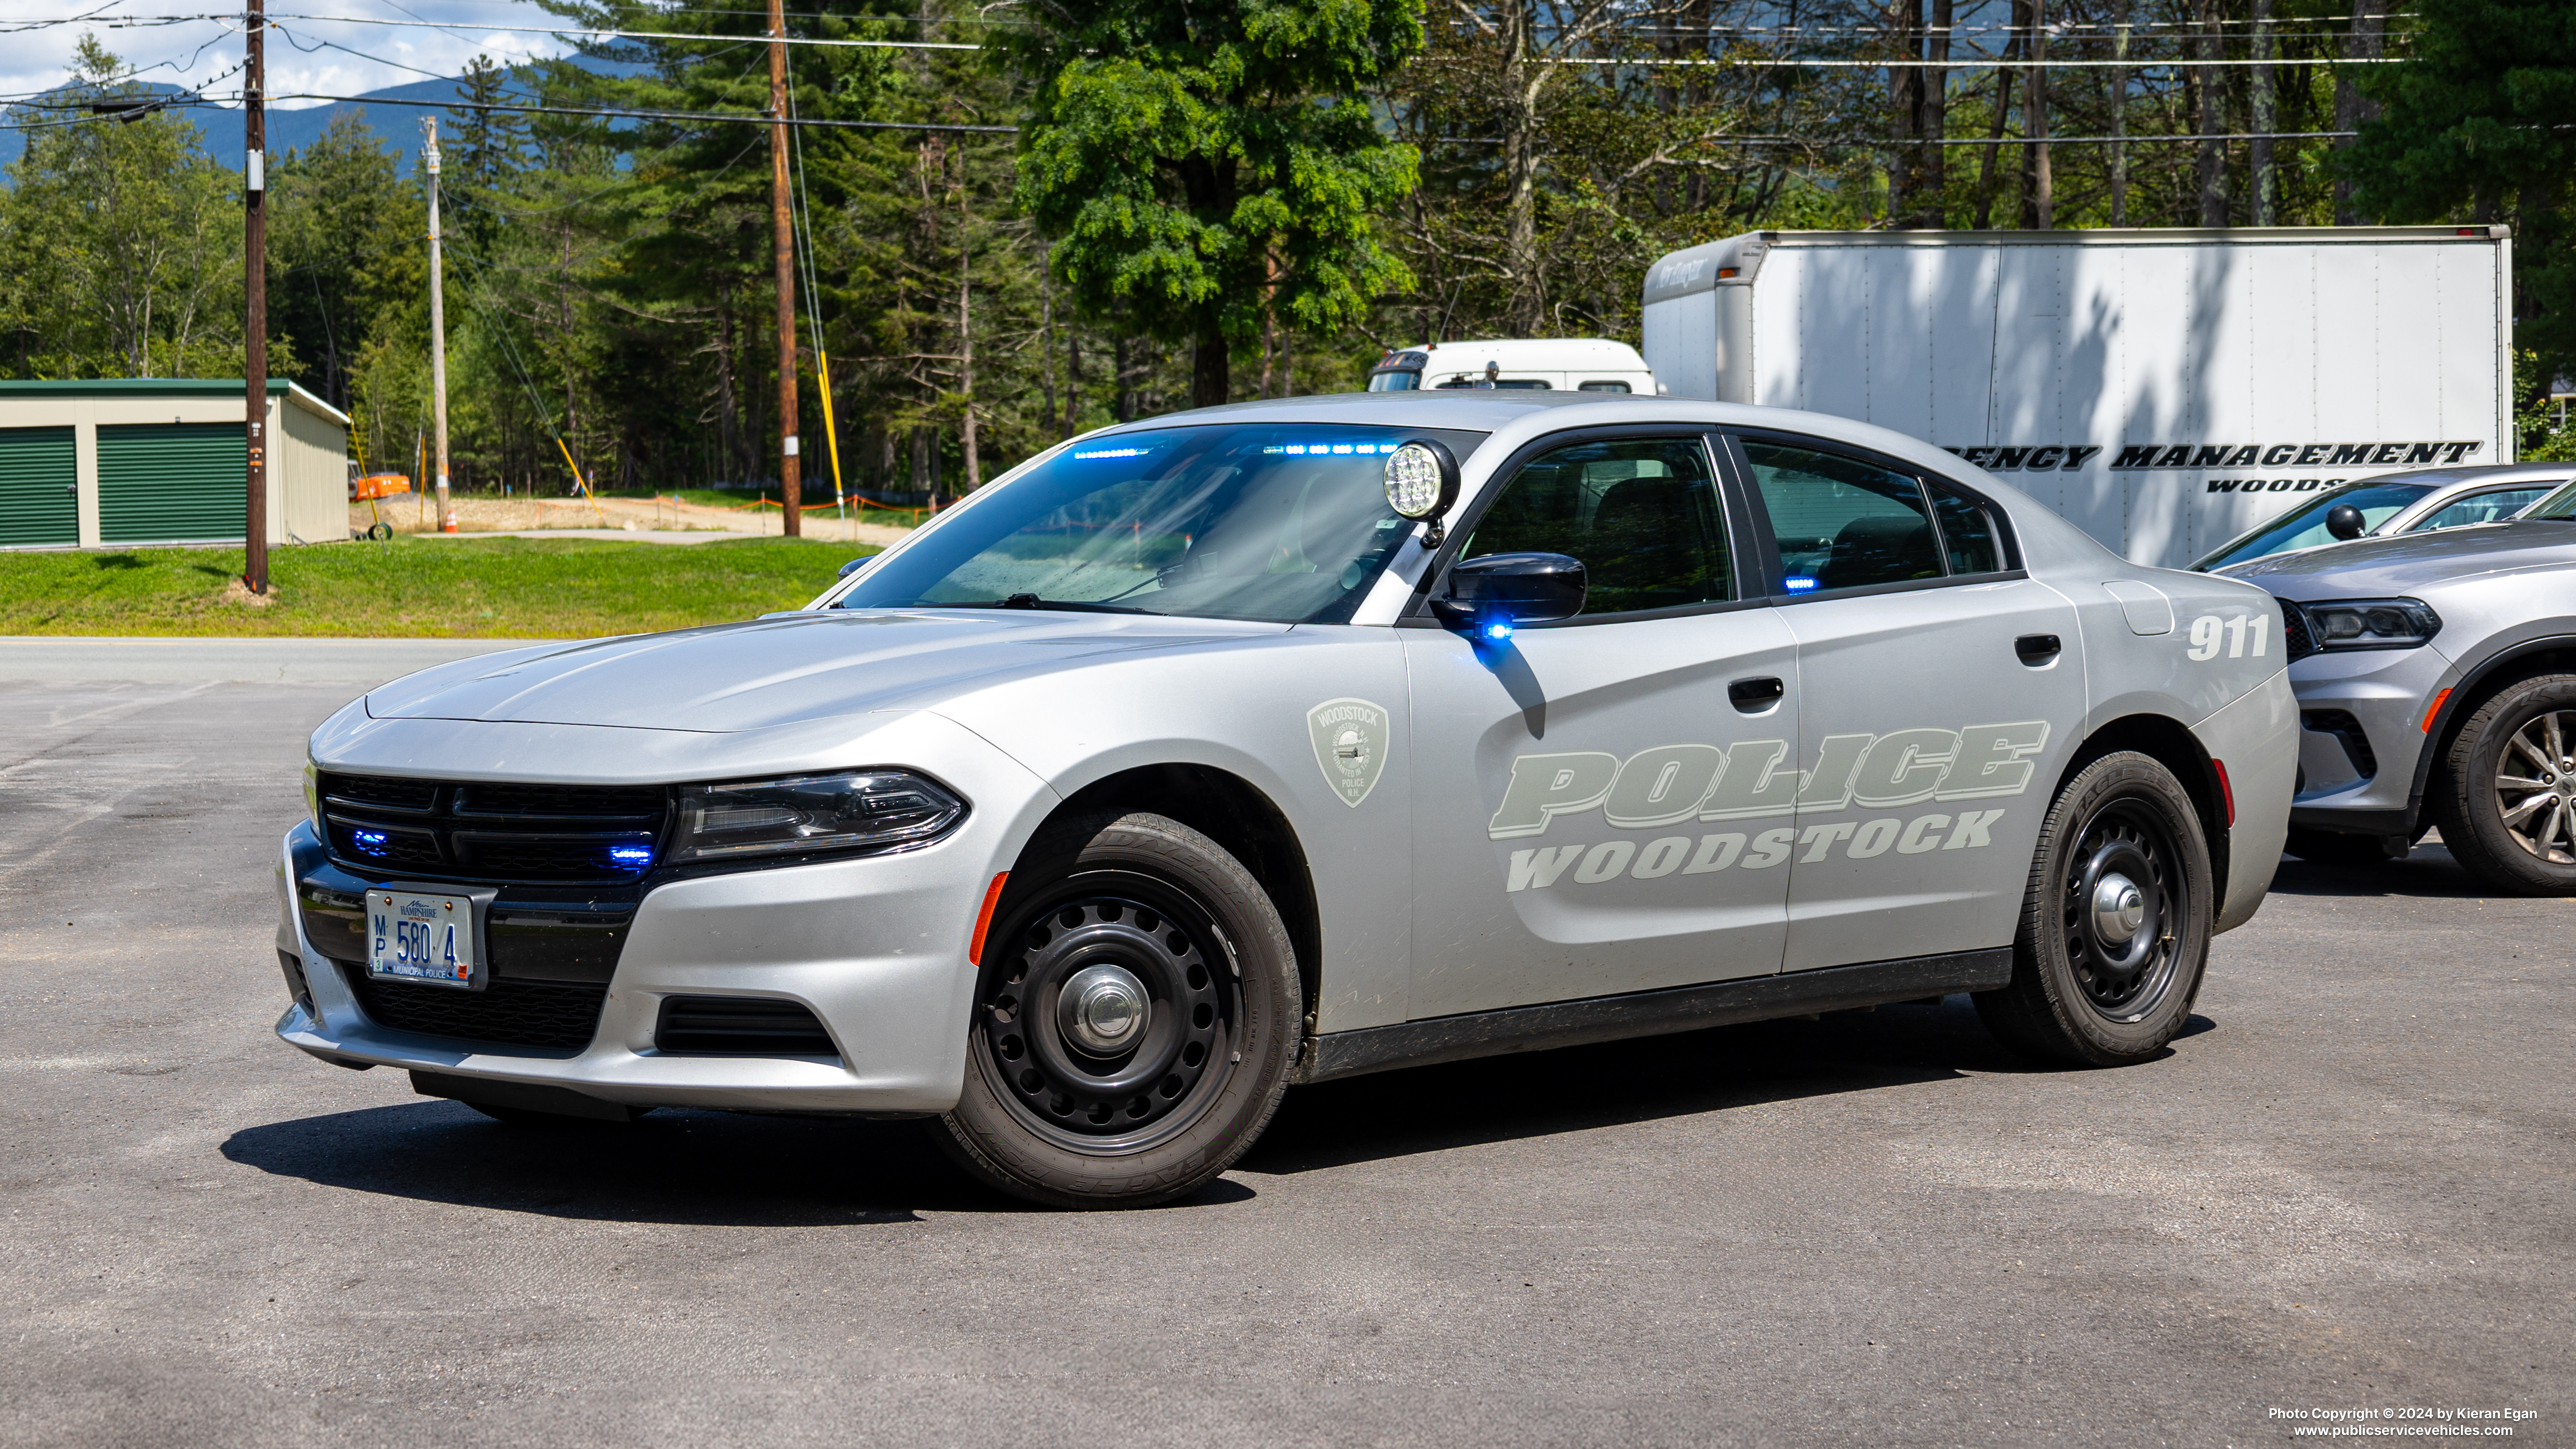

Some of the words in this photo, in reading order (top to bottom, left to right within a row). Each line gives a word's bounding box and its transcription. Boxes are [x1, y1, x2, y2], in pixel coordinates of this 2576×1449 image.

[1940, 445, 2103, 472] ENCY
[2109, 441, 2485, 471] MANAGEMENT
[2187, 614, 2270, 662] 911
[1317, 706, 1378, 728] WOODSTOCK
[1332, 723, 1359, 747] WOODSTOCK
[1334, 756, 1355, 777] GRANTED
[1355, 768, 1361, 776] IN
[1342, 778, 1364, 787] POLICE
[1487, 720, 2051, 841] POLICE
[1348, 788, 1360, 797] N.H.
[1506, 809, 2006, 892] WOODSTOCK
[400, 906, 437, 918] HAMPSHIRE
[397, 921, 431, 963] 580
[444, 924, 456, 966] 4
[377, 960, 381, 969] 3
[393, 966, 424, 977] MUNICIPAL
[425, 968, 446, 978] POLICE
